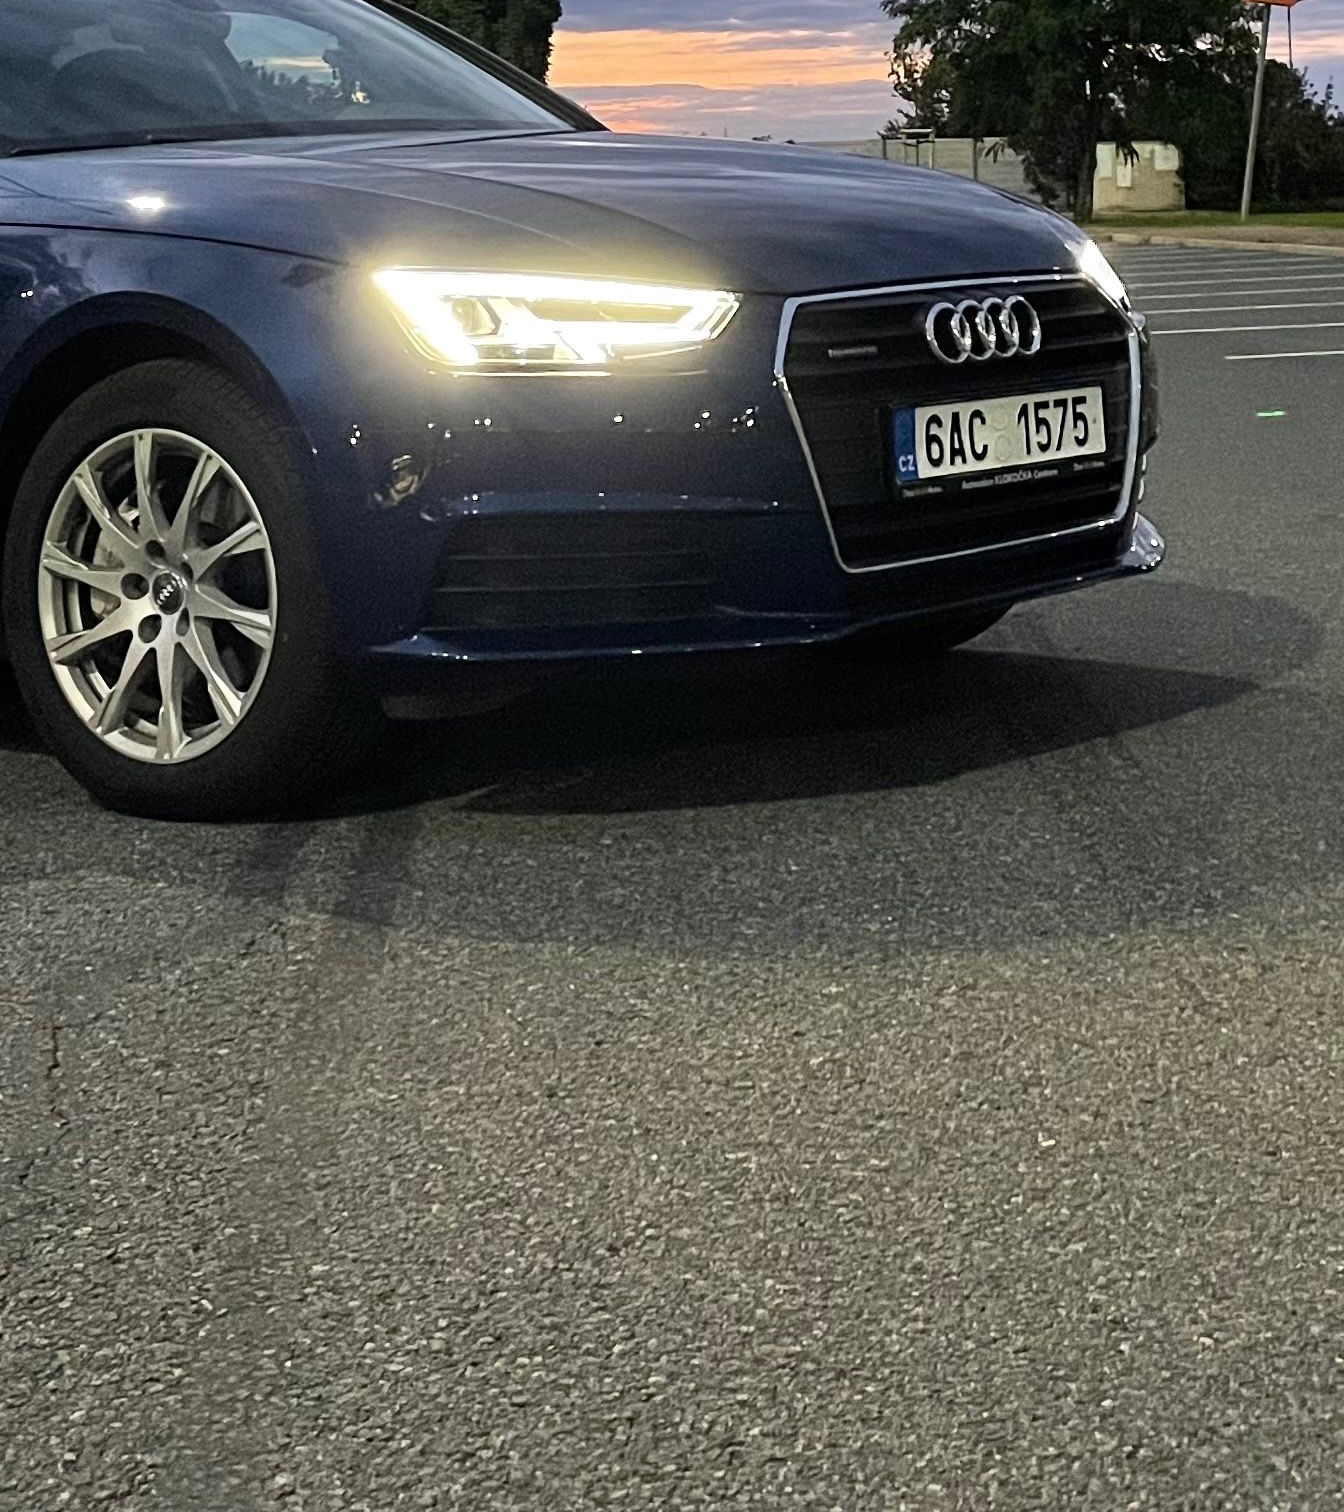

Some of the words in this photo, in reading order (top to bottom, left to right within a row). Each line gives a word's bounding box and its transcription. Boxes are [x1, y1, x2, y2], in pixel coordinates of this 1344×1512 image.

[925, 409, 989, 468] 6AC
[1017, 396, 1089, 455] 1575
[898, 454, 915, 472] CZ
